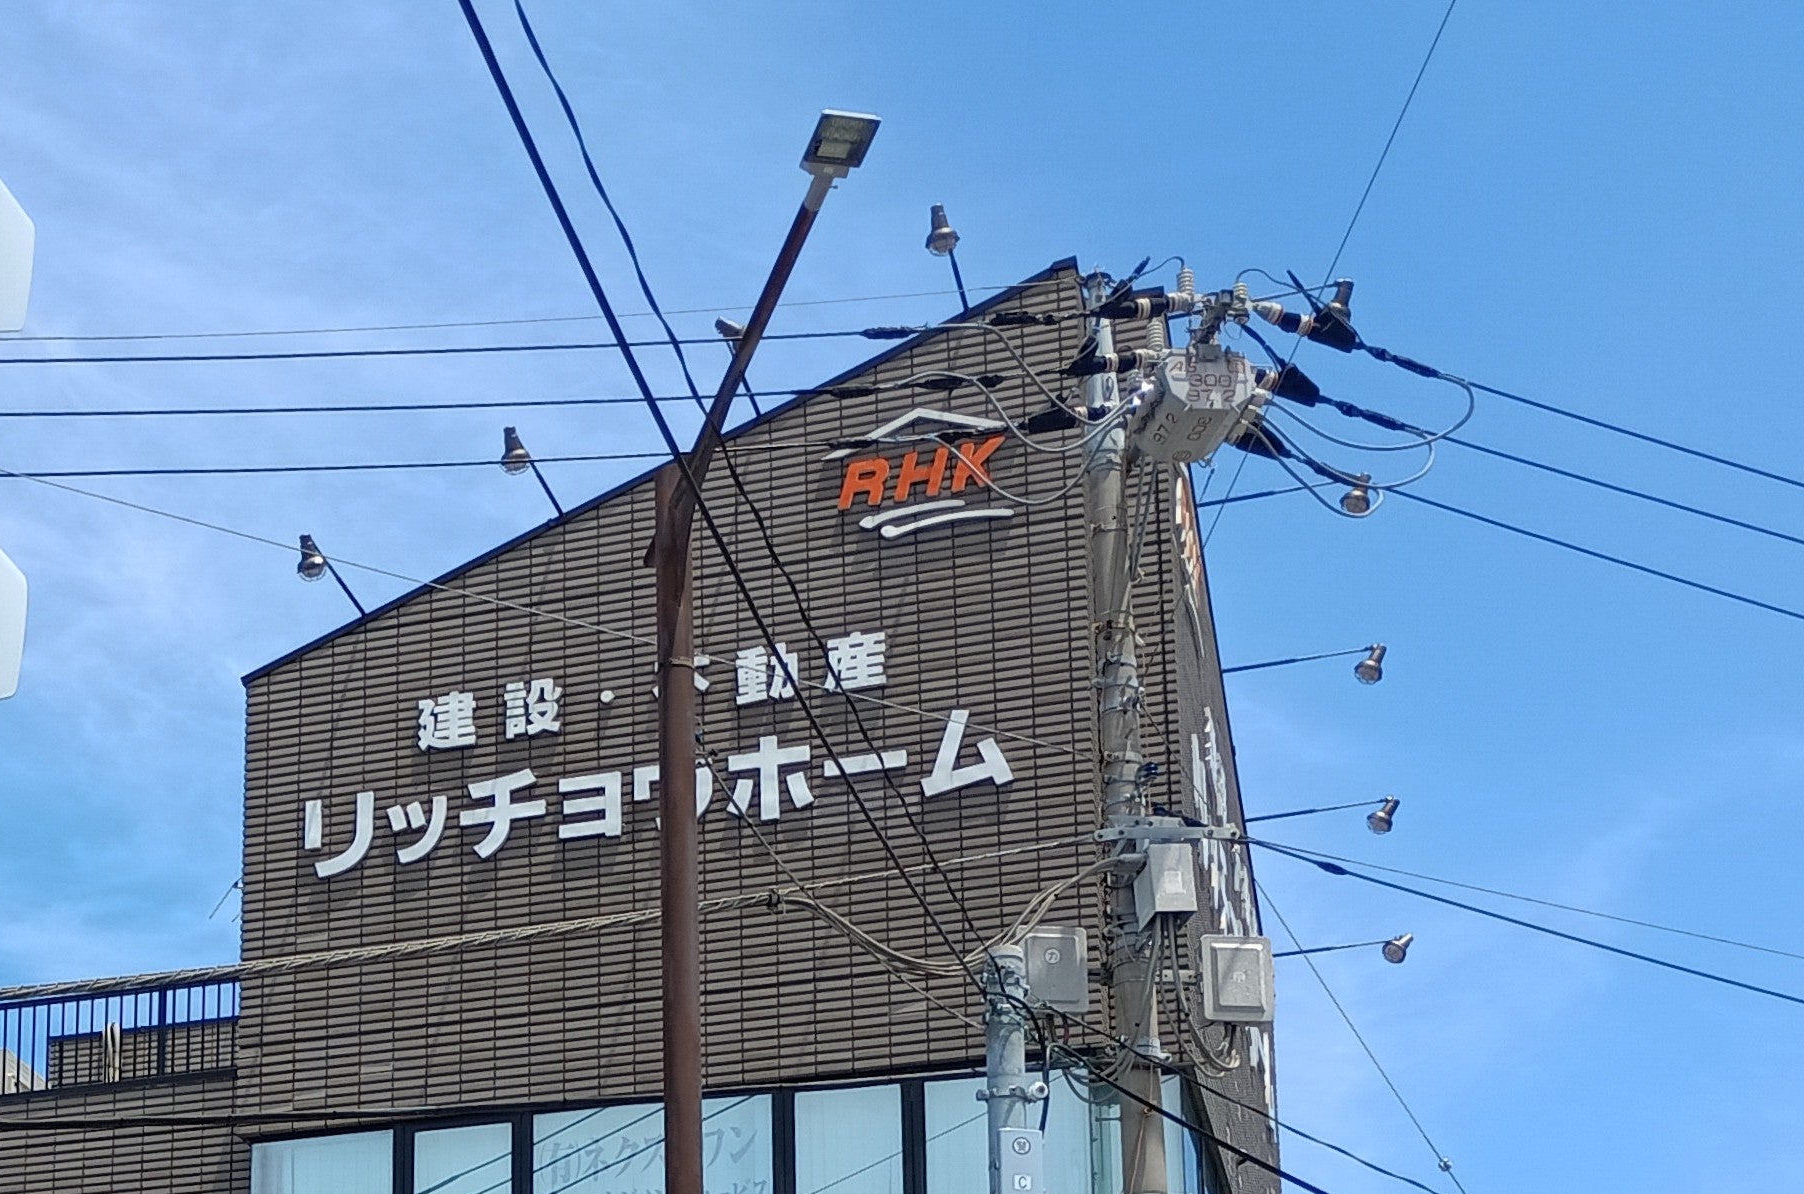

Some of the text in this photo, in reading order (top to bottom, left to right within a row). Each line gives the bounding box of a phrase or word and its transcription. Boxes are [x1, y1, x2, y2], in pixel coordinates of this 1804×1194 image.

[838, 435, 1006, 511] RHK
[415, 630, 888, 752] 建設・動産
